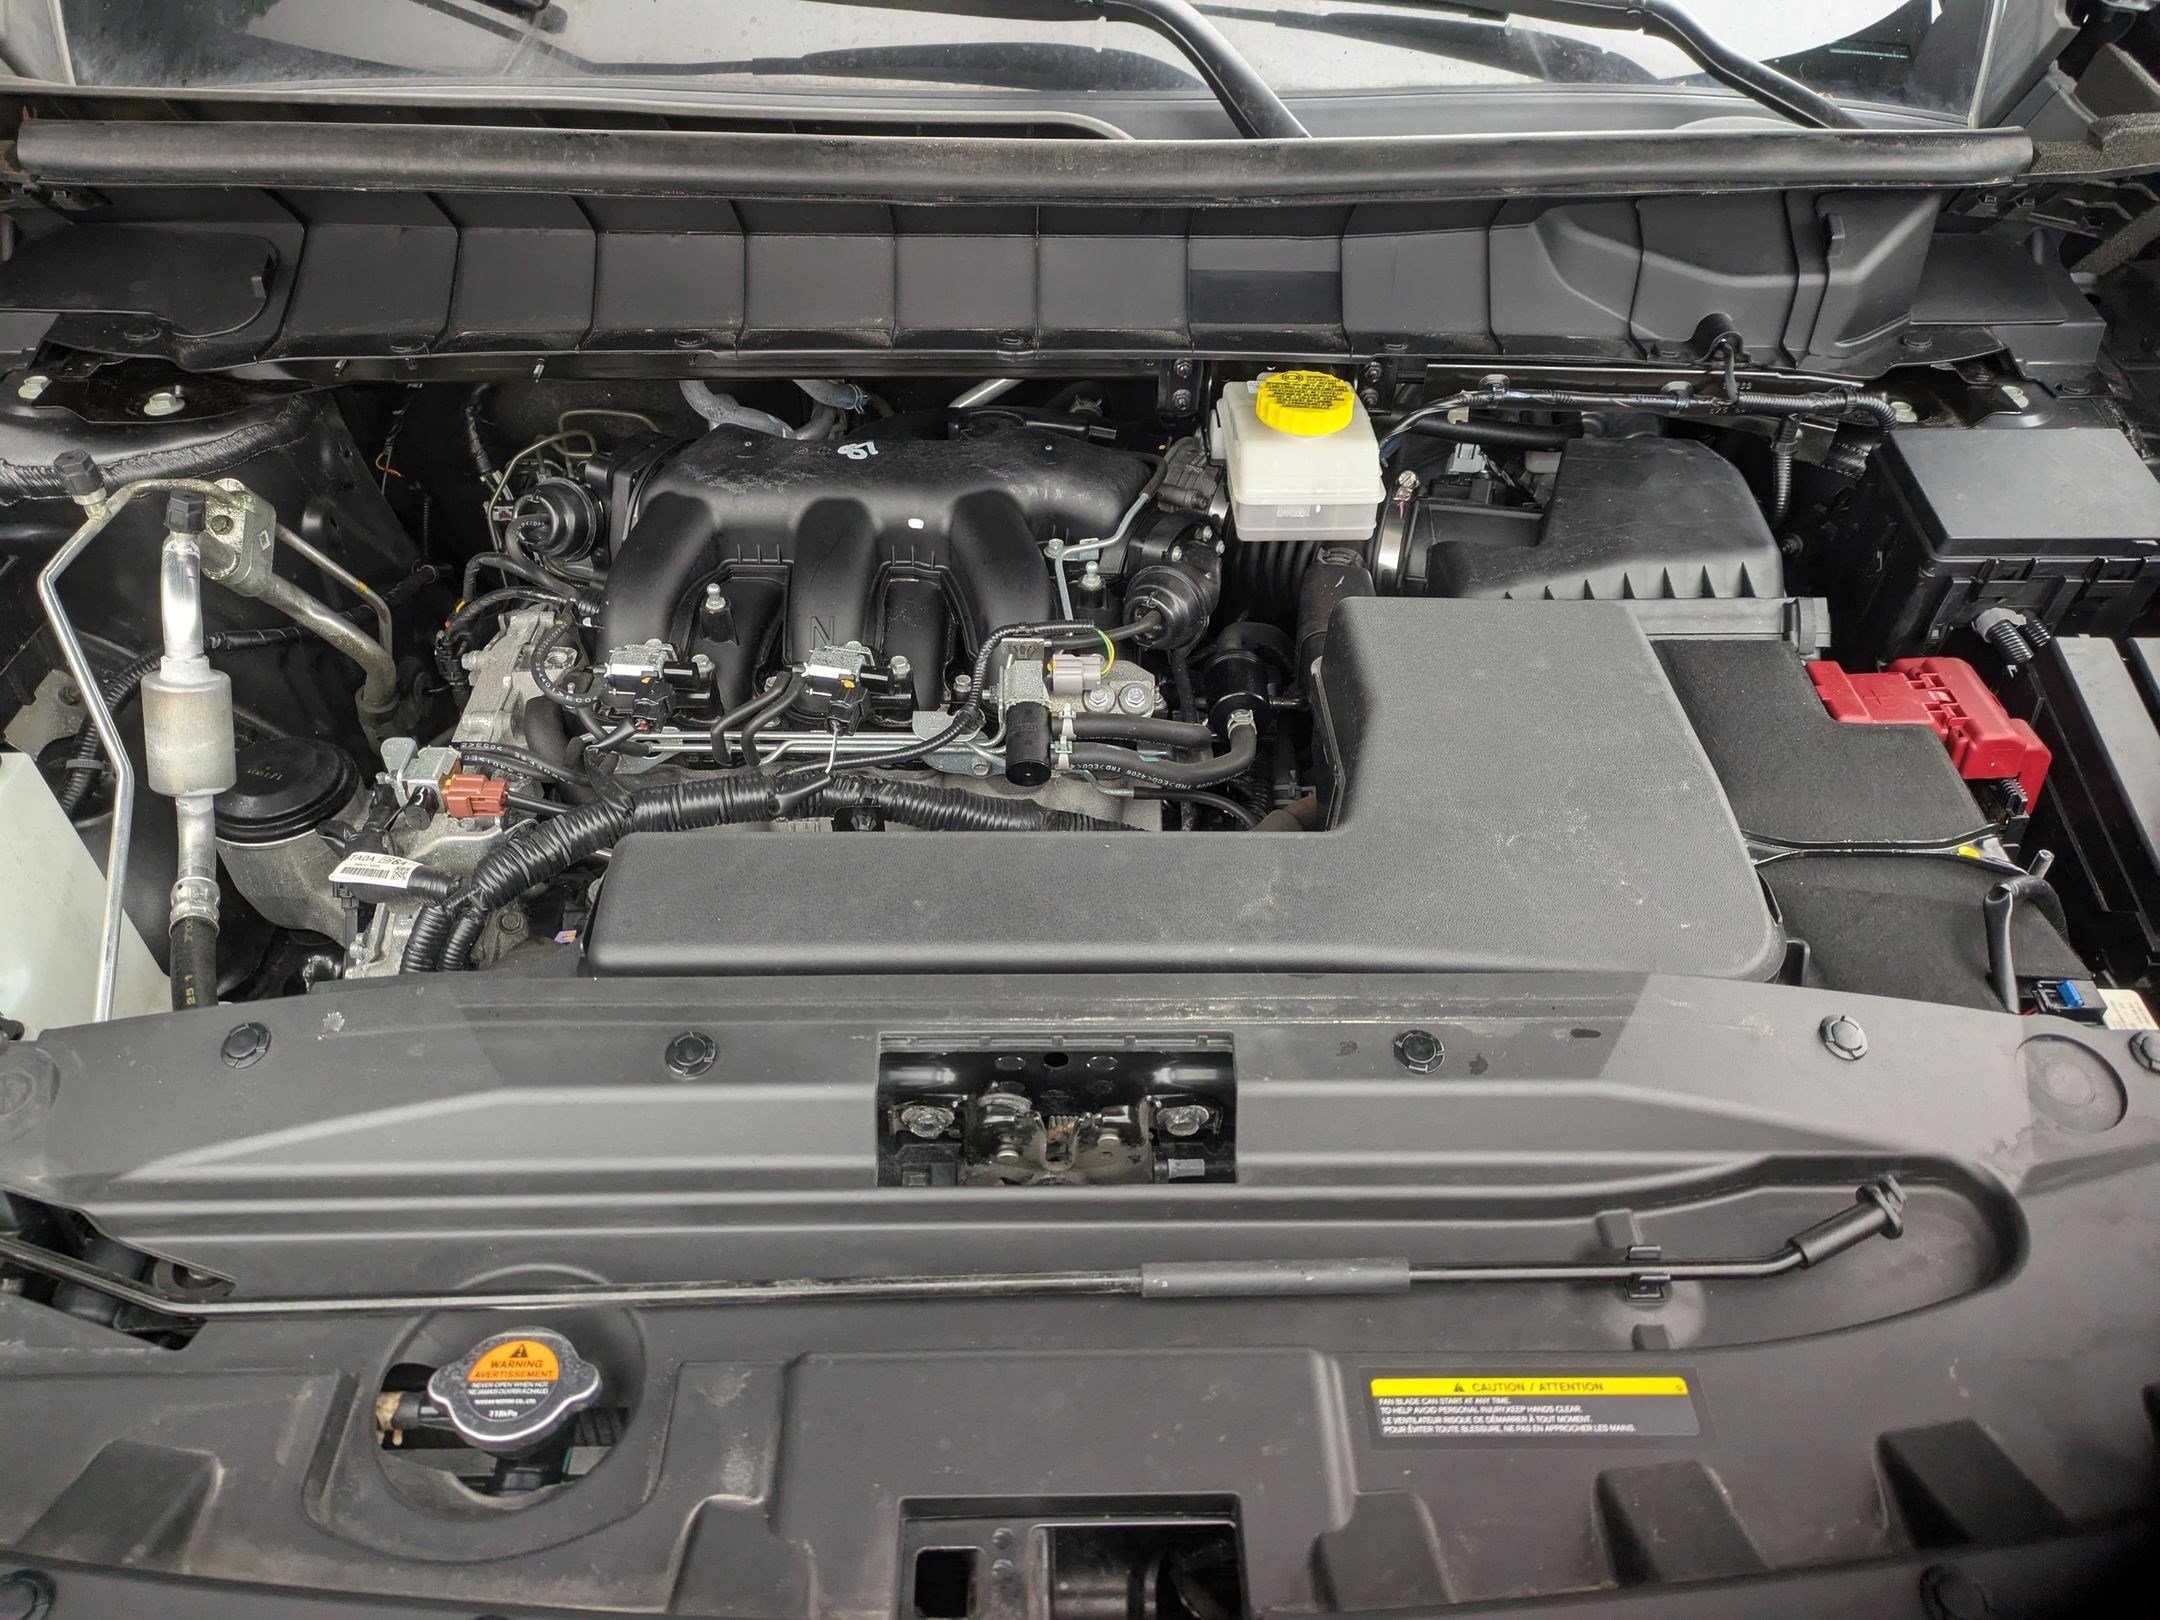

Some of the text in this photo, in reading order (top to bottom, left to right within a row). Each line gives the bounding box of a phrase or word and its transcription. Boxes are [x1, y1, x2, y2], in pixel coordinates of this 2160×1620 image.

[491, 1360, 544, 1368] WARNING
[475, 1370, 554, 1378] AVERTISSEMENT
[1472, 1382, 1526, 1393] CAUTION
[1538, 1382, 1604, 1393] ATTENTION
[1379, 1397, 1395, 1405] FAN
[1395, 1397, 1421, 1405] BLADE
[1421, 1397, 1439, 1405] CAN
[1440, 1397, 1463, 1405] START
[1464, 1397, 1474, 1405] AT
[1380, 1406, 1392, 1415] TO
[1393, 1406, 1414, 1415] HELP
[1413, 1406, 1438, 1415] AVOID
[1438, 1406, 1479, 1415] PERSONAL
[1527, 1405, 1555, 1414] HANDS
[1381, 1415, 1393, 1424] LE
[1393, 1415, 1442, 1424] VENTILATEUR
[1443, 1415, 1473, 1424] RISQUE
[1473, 1415, 1484, 1424] DE
[1485, 1413, 1529, 1424] DÉMARRER
[1536, 1415, 1556, 1423] TOUT
[1383, 1425, 1407, 1433] POUR
[1434, 1425, 1460, 1433] TOUTE
[1503, 1425, 1515, 1433] NE
[1515, 1425, 1532, 1433] PAS
[1532, 1425, 1545, 1433] EN
[1545, 1424, 1593, 1432] APPROCHER
[1593, 1424, 1609, 1432] LES
